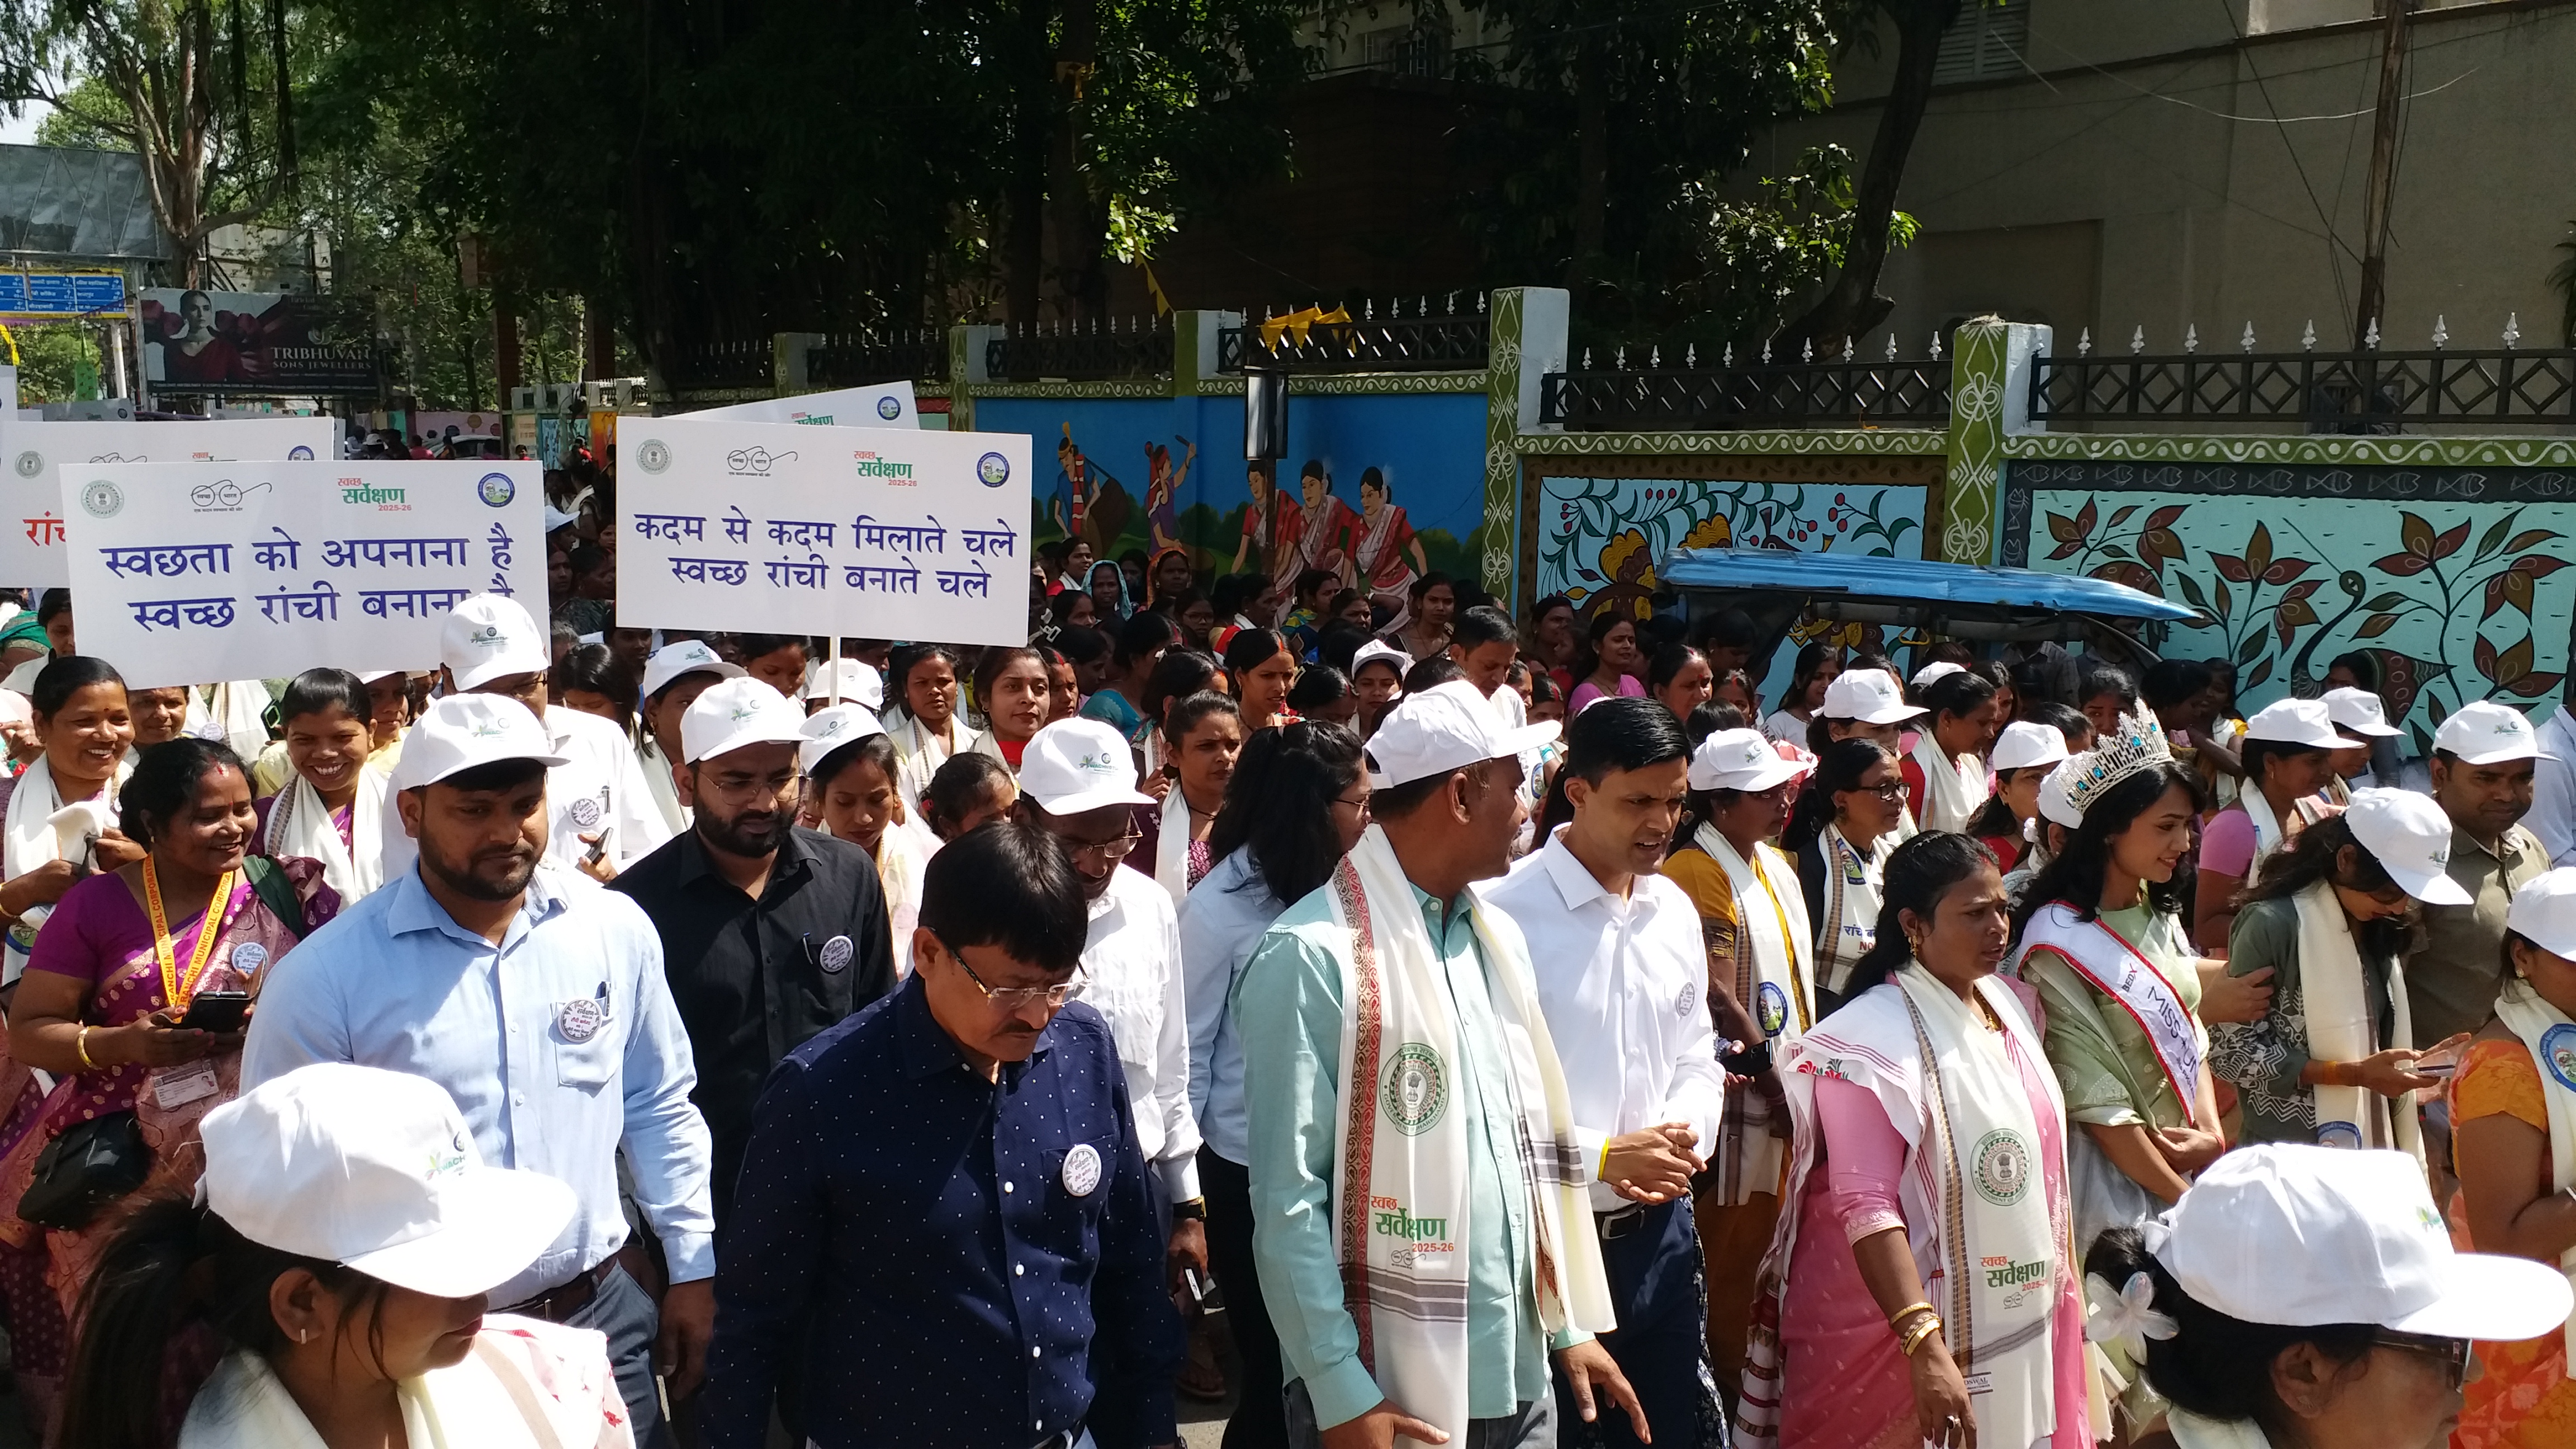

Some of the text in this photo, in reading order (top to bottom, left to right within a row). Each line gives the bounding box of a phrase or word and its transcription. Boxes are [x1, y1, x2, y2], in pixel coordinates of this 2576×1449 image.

[271, 347, 370, 361] TRIBHUVAN
[309, 361, 372, 370] JEWELLERS
[854, 451, 876, 460] स्वच्छ
[856, 457, 913, 479] सर्वेक्षण
[338, 478, 362, 486] स्वच्छ
[342, 483, 405, 504] सर्वेक्षण
[23, 510, 66, 547] रांच
[634, 505, 1017, 558] कदम से कदम मिलाते चले
[99, 522, 514, 580] स्वछता को अपनाना है
[668, 553, 992, 599] स्वच्छ रांची बनाते चले
[128, 596, 236, 633] स्वच्छ
[255, 580, 340, 625] रांची
[180, 967, 200, 1003] RANCHI
[193, 916, 217, 965] MUNICIPAL
[2147, 985, 2181, 1039] MISS
[1384, 1093, 1409, 1131] GOVERMENT
[1371, 1196, 1398, 1210] स्वच्छ
[1375, 1208, 1447, 1242] सर्वेक्षण
[1412, 1242, 1454, 1253] 2025-26
[1980, 1256, 2007, 1267] स्वच्छ
[1986, 1260, 2045, 1288] सर्वेक्षण
